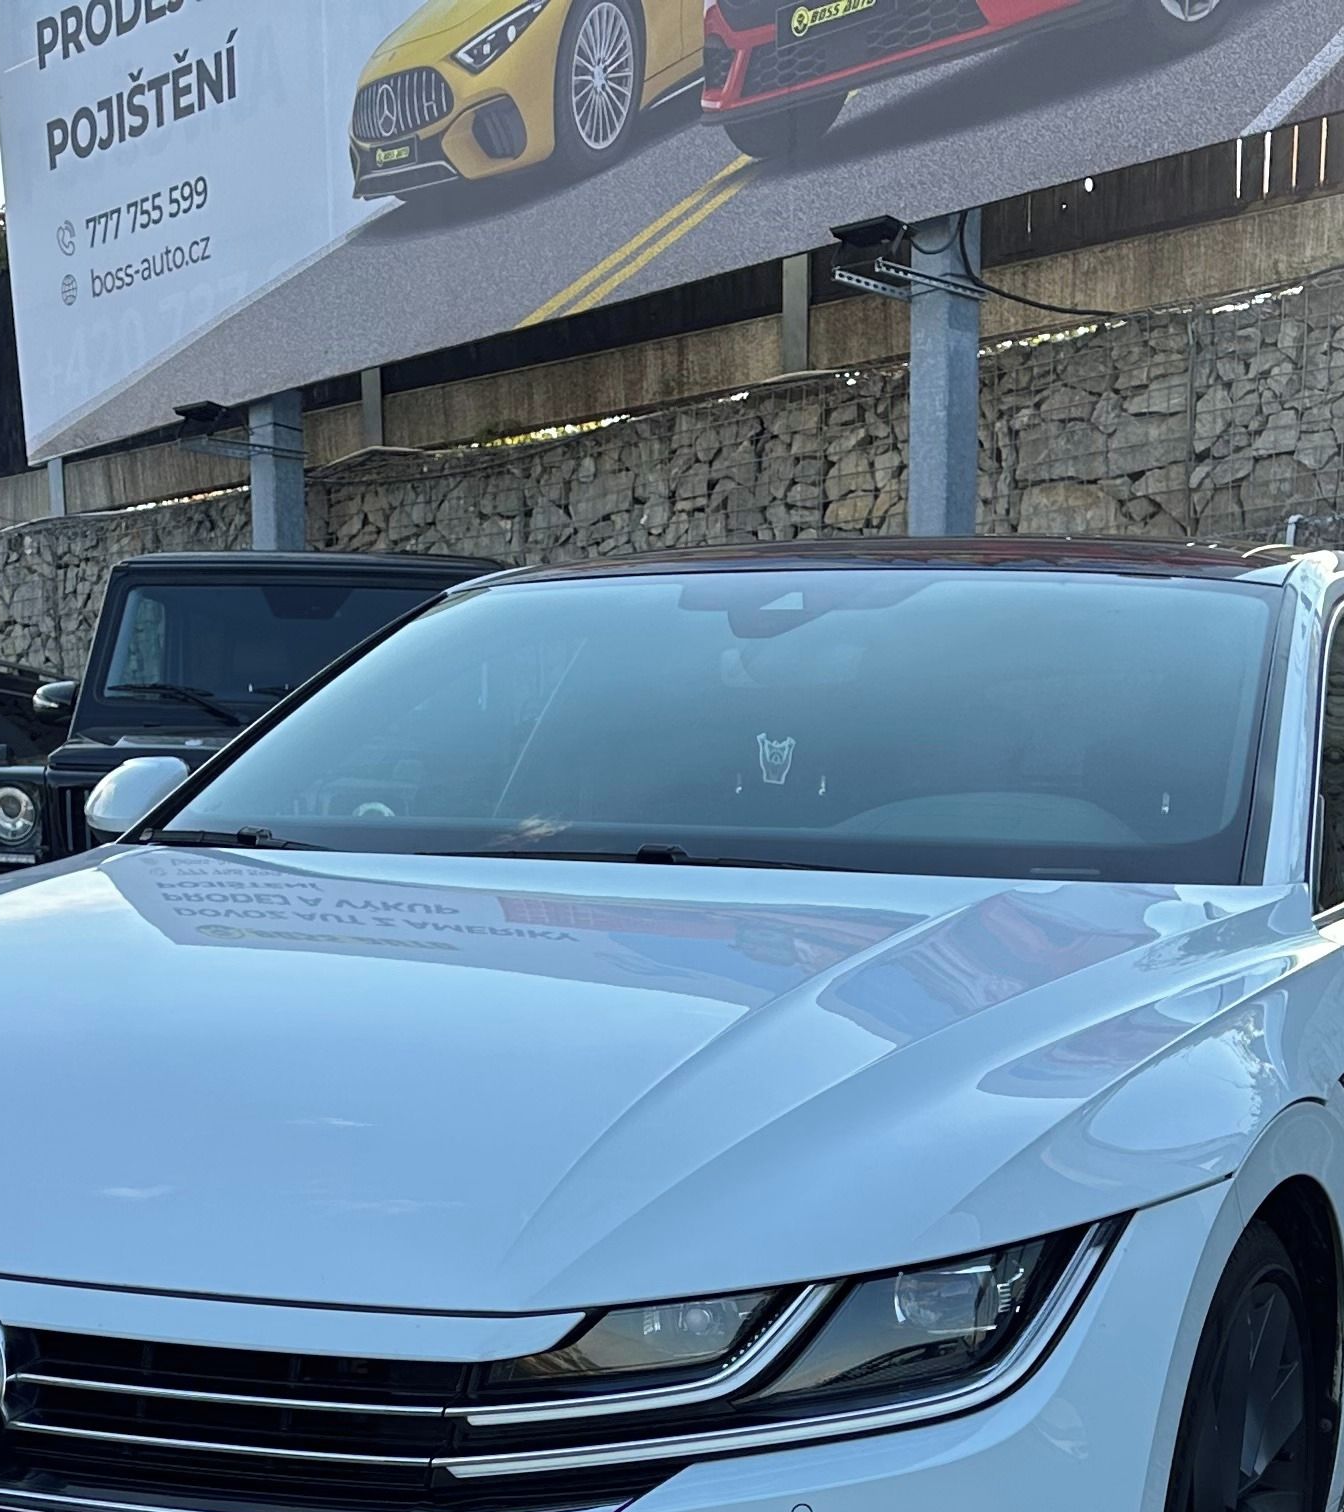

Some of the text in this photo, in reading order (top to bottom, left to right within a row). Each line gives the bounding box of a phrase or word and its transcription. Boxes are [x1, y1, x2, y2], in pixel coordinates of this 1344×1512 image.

[46, 27, 239, 171] POJIŠTĚNÍ
[85, 175, 208, 248] 777 755 599
[90, 236, 211, 298] boss-auto.cz
